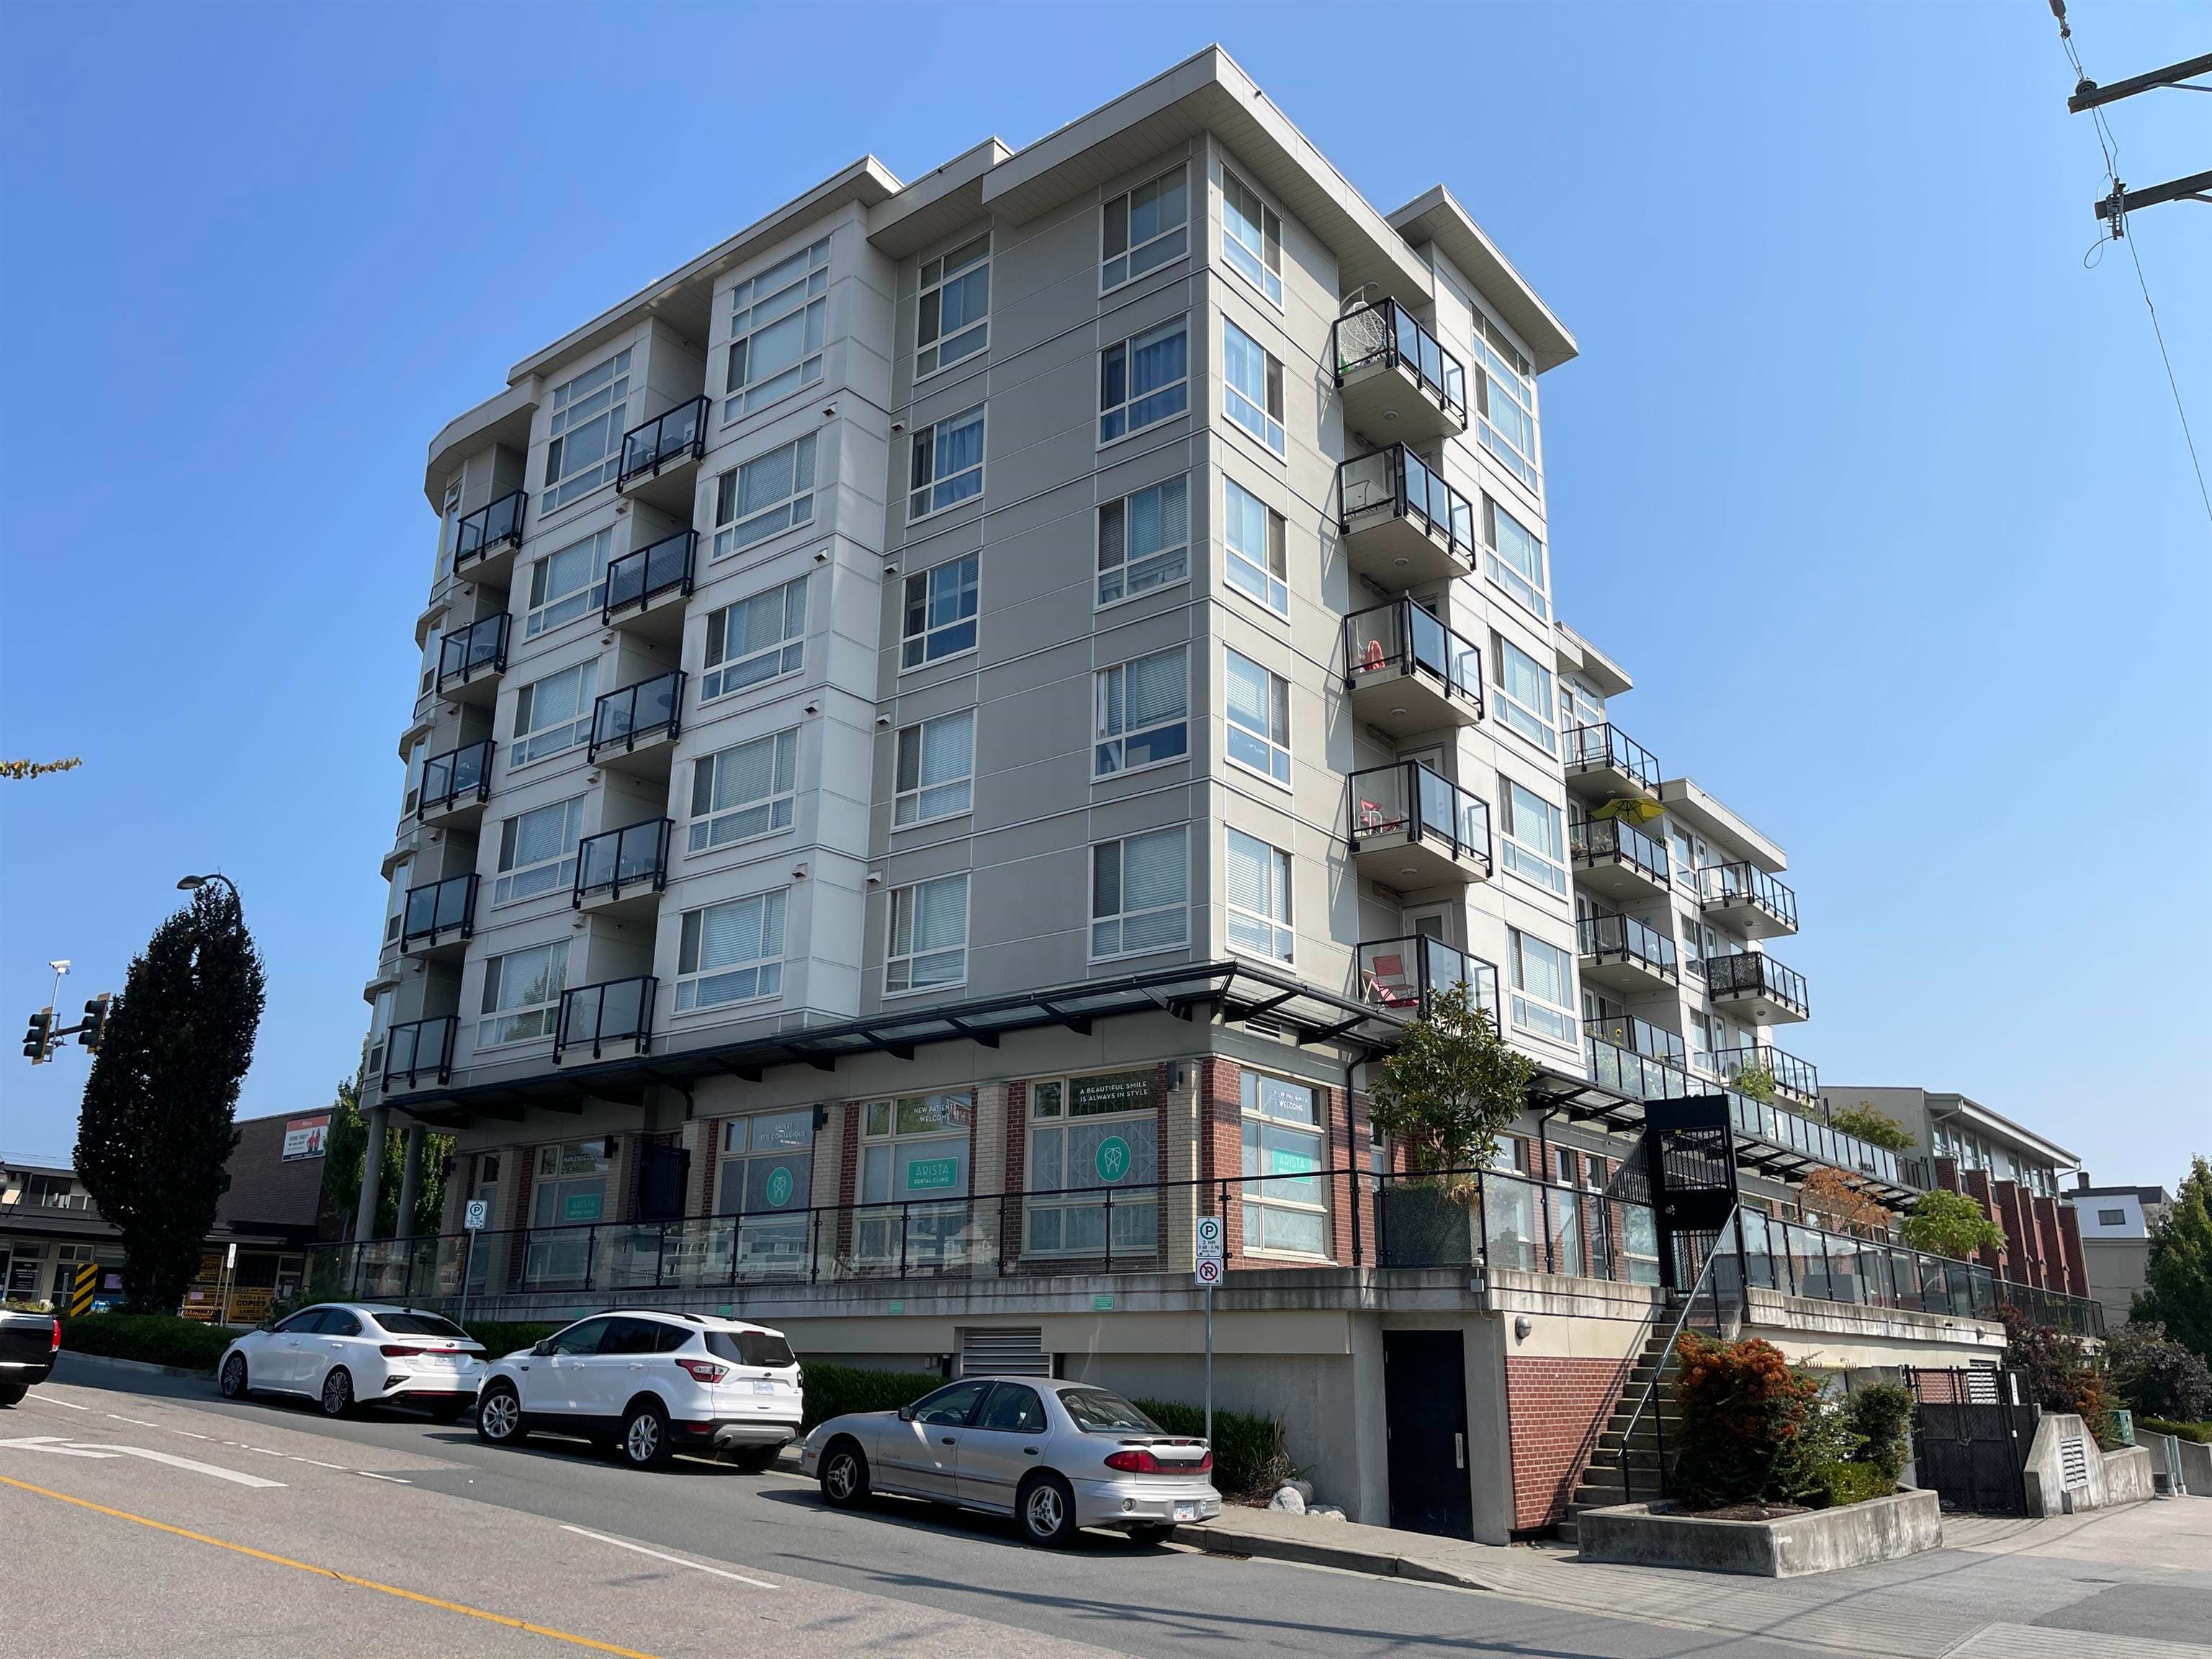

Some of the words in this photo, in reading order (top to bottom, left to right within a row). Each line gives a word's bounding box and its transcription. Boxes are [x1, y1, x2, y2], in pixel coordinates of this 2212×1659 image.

[1087, 1084, 1124, 1094] BEAUTIFUL
[1125, 1081, 1147, 1089] SMILE
[1088, 1093, 1115, 1102] ALWAYS
[929, 1103, 957, 1112] PATIENTS
[1279, 1100, 1303, 1111] WELCOME
[920, 1113, 950, 1123] WELCOME
[1279, 1154, 1305, 1169] ARISTA
[915, 1164, 949, 1177] ARISTA
[1205, 1226, 1214, 1236] P
